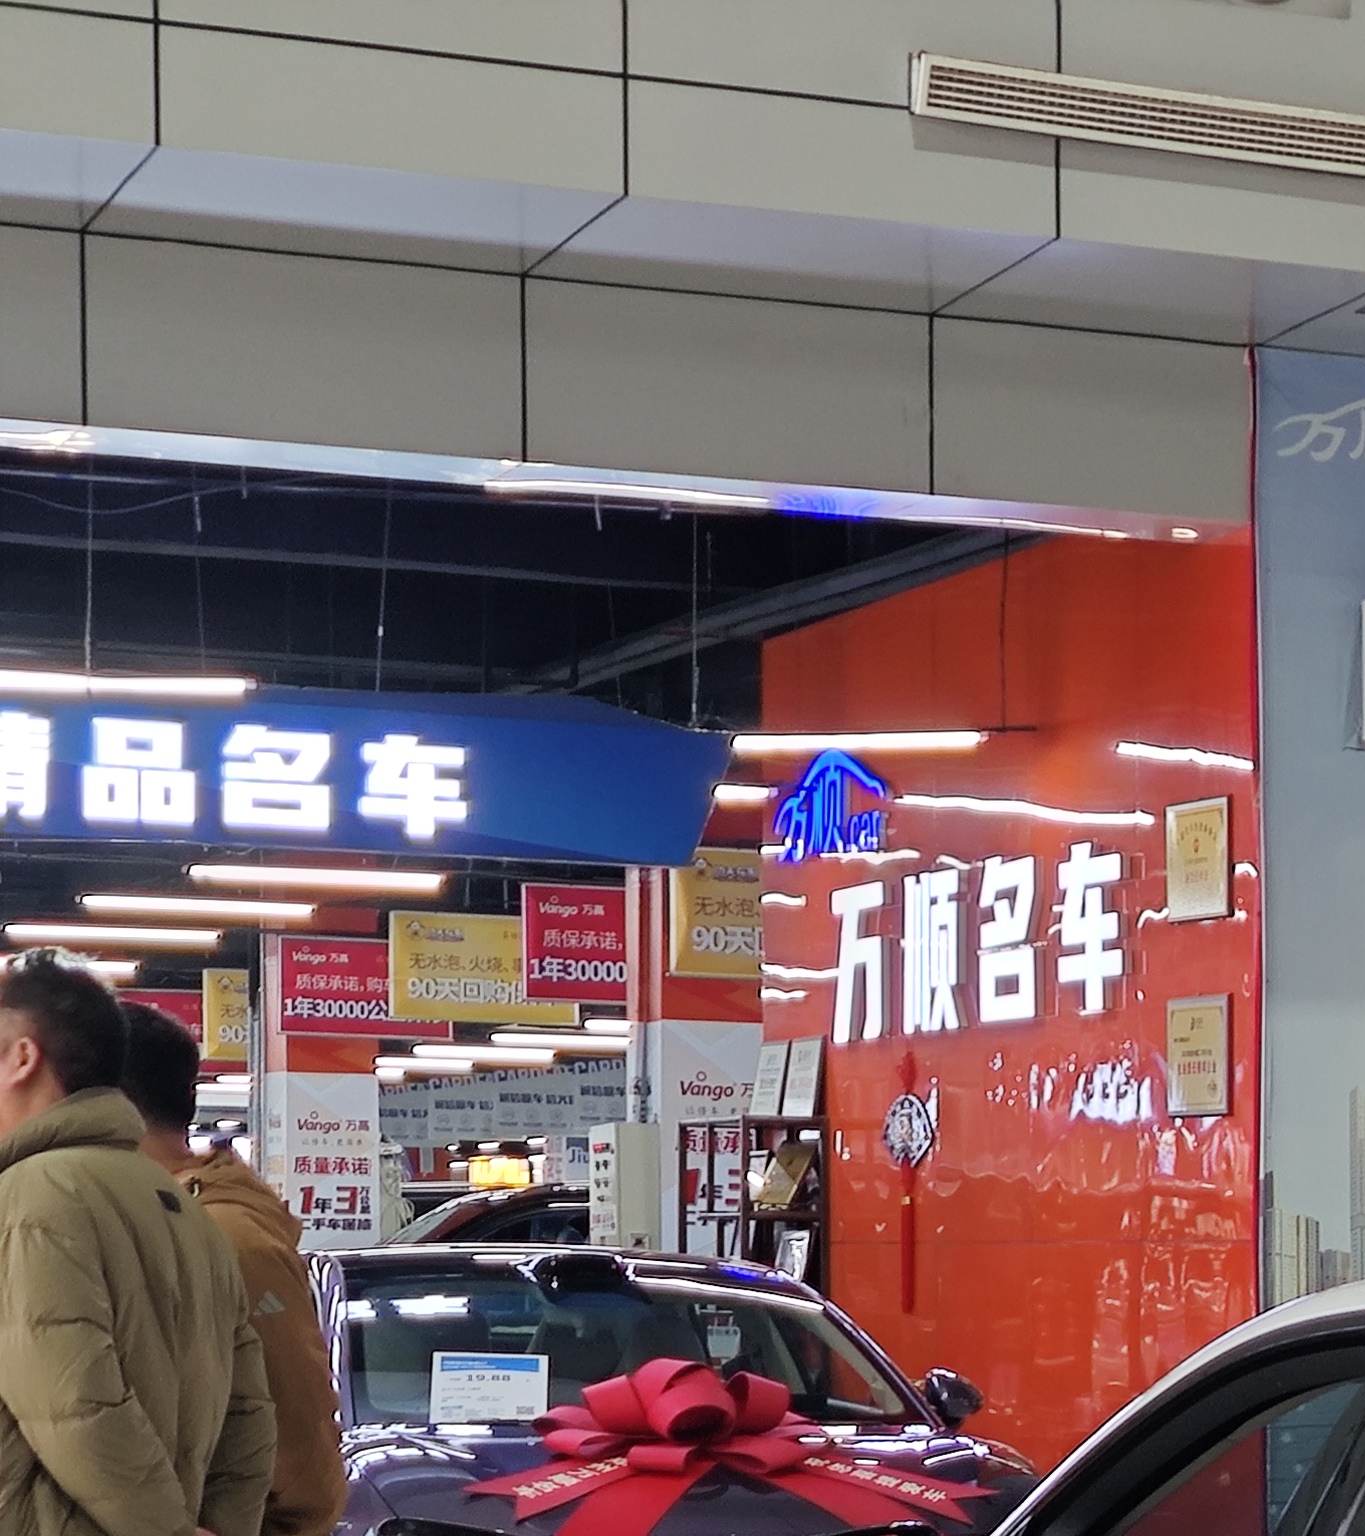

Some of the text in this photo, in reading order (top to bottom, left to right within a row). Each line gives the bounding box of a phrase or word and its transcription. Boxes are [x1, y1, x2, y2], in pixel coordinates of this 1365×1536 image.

[831, 842, 1124, 1043] 万顺名车
[218, 1024, 248, 1044] 90
[679, 1073, 735, 1100] Vango
[297, 1112, 340, 1134] Vango
[293, 1154, 371, 1176] 质量承诺
